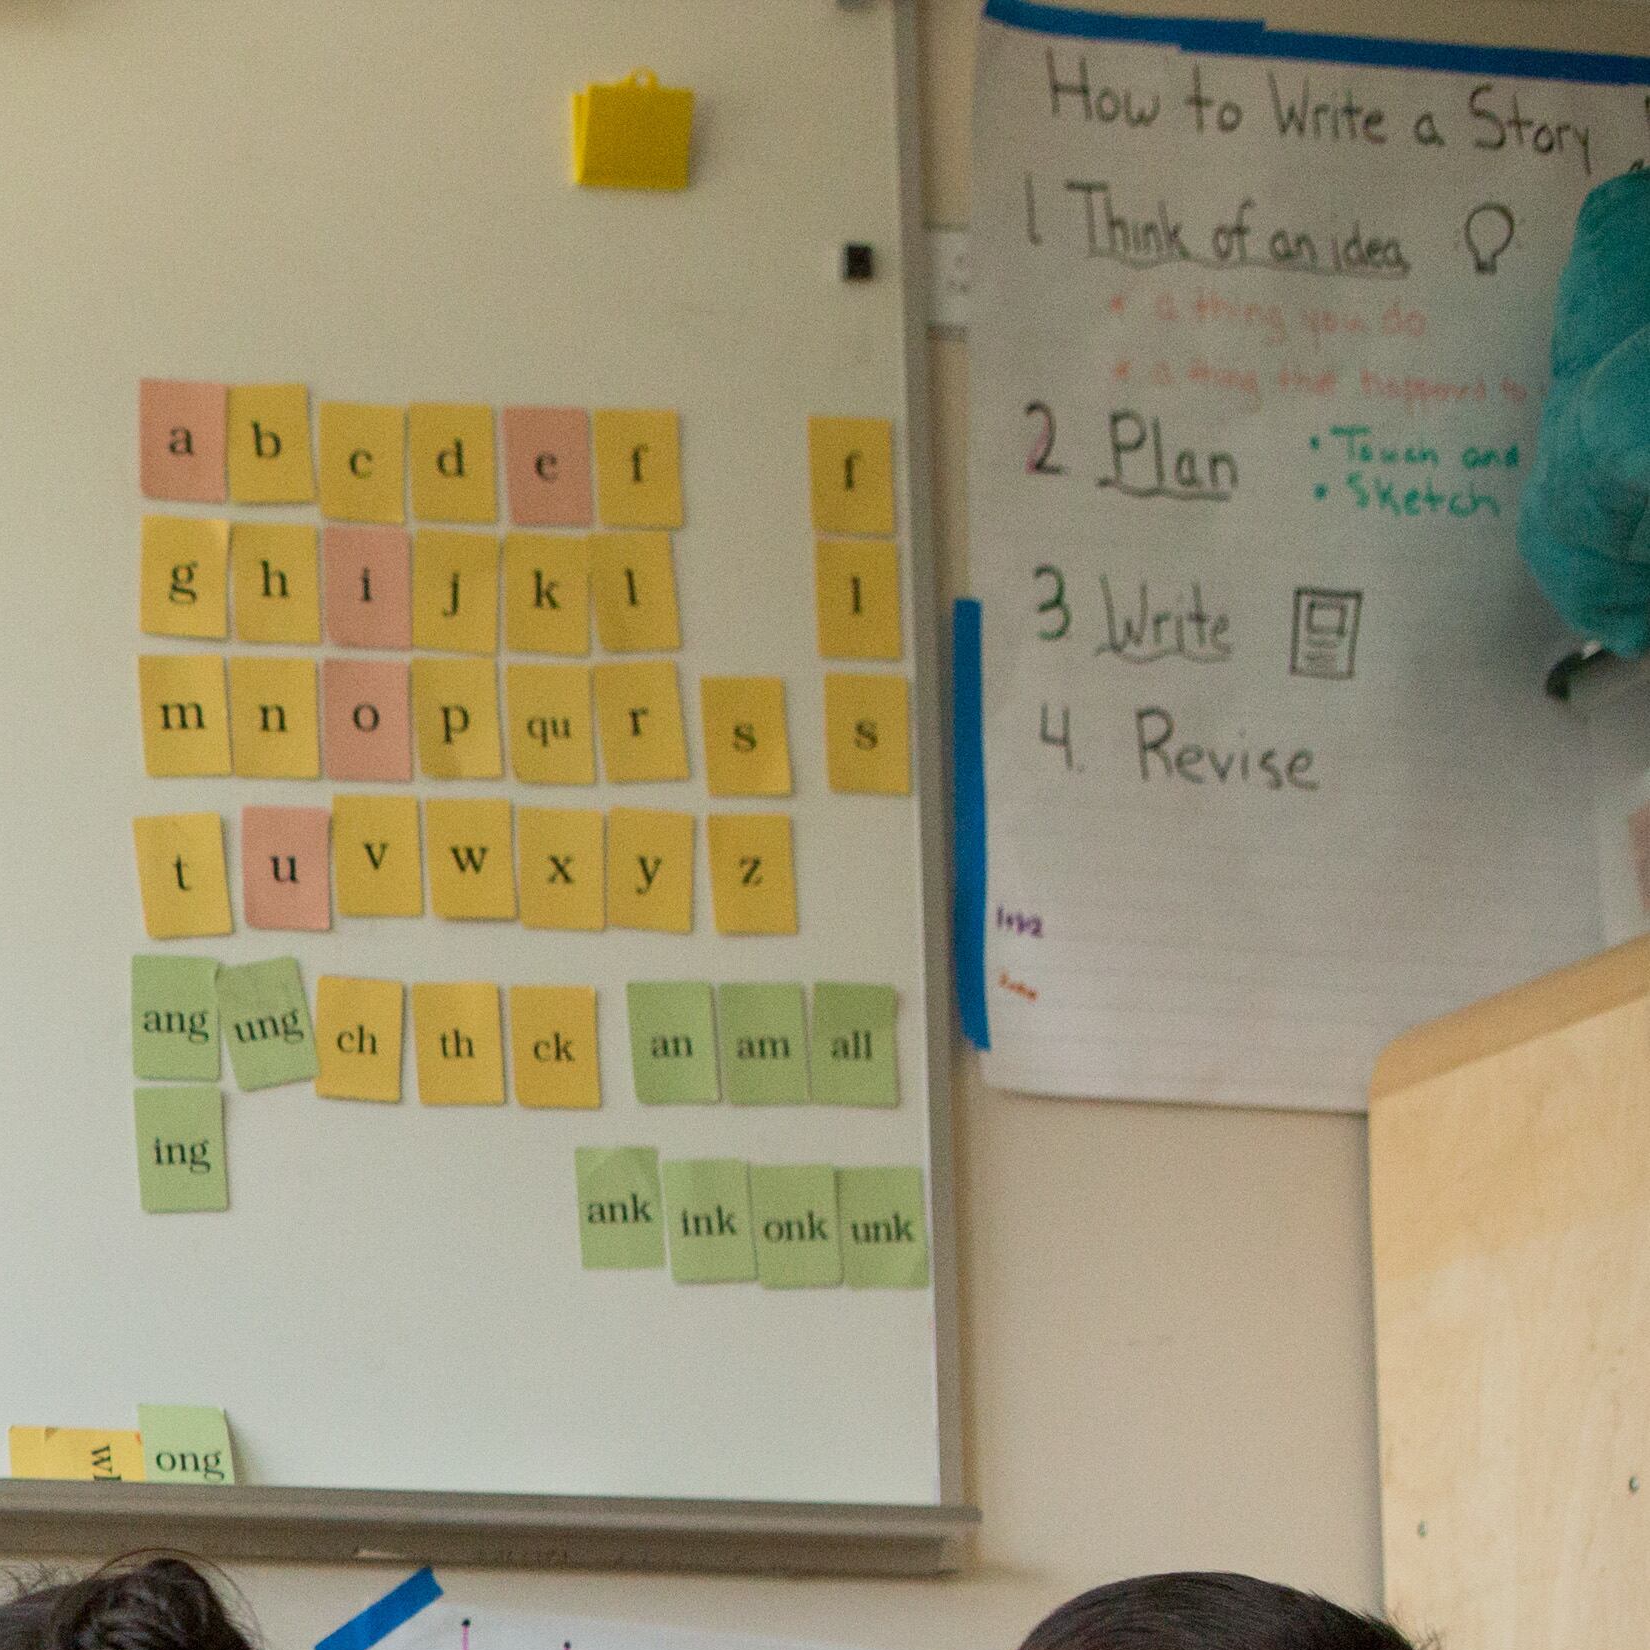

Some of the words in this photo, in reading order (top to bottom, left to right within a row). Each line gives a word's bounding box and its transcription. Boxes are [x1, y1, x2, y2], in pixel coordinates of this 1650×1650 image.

[1045, 48, 1161, 122] How
[1185, 64, 1243, 134] to
[1268, 70, 1388, 146] Write
[1413, 108, 1447, 149] a
[1468, 82, 1593, 176] Story
[1064, 180, 1187, 260] Think
[1211, 198, 1256, 262] of
[1269, 228, 1318, 263] an
[1331, 230, 1414, 272] idea
[168, 424, 194, 457] a
[251, 420, 282, 458] b
[436, 438, 465, 477] d
[1023, 401, 1069, 475] 2
[1107, 410, 1239, 487] Plan
[169, 560, 198, 605] g
[260, 559, 290, 599] h
[534, 569, 560, 609] k
[1032, 564, 1071, 641] 3
[1098, 571, 1233, 656] Write
[159, 701, 205, 730] m
[260, 703, 288, 733] n
[353, 702, 381, 732] o
[439, 703, 471, 745] p
[526, 714, 572, 747] qu
[1135, 705, 1321, 791] Revise
[172, 853, 192, 891] t
[270, 854, 300, 883] u
[363, 841, 389, 871] v
[450, 843, 489, 874] w
[635, 854, 663, 895] y
[142, 1008, 210, 1045] ang
[233, 1007, 304, 1045] ung
[336, 1024, 378, 1056] ch
[439, 1028, 475, 1059] th
[532, 1031, 576, 1063] ck
[650, 1033, 694, 1060] an
[736, 1034, 792, 1060] am
[830, 1029, 873, 1061] all
[153, 1136, 212, 1173] ing
[586, 1192, 653, 1226] ank
[680, 1204, 737, 1239] ink
[763, 1209, 830, 1243] onk
[851, 1211, 915, 1245] unk
[156, 1449, 225, 1484] ong
